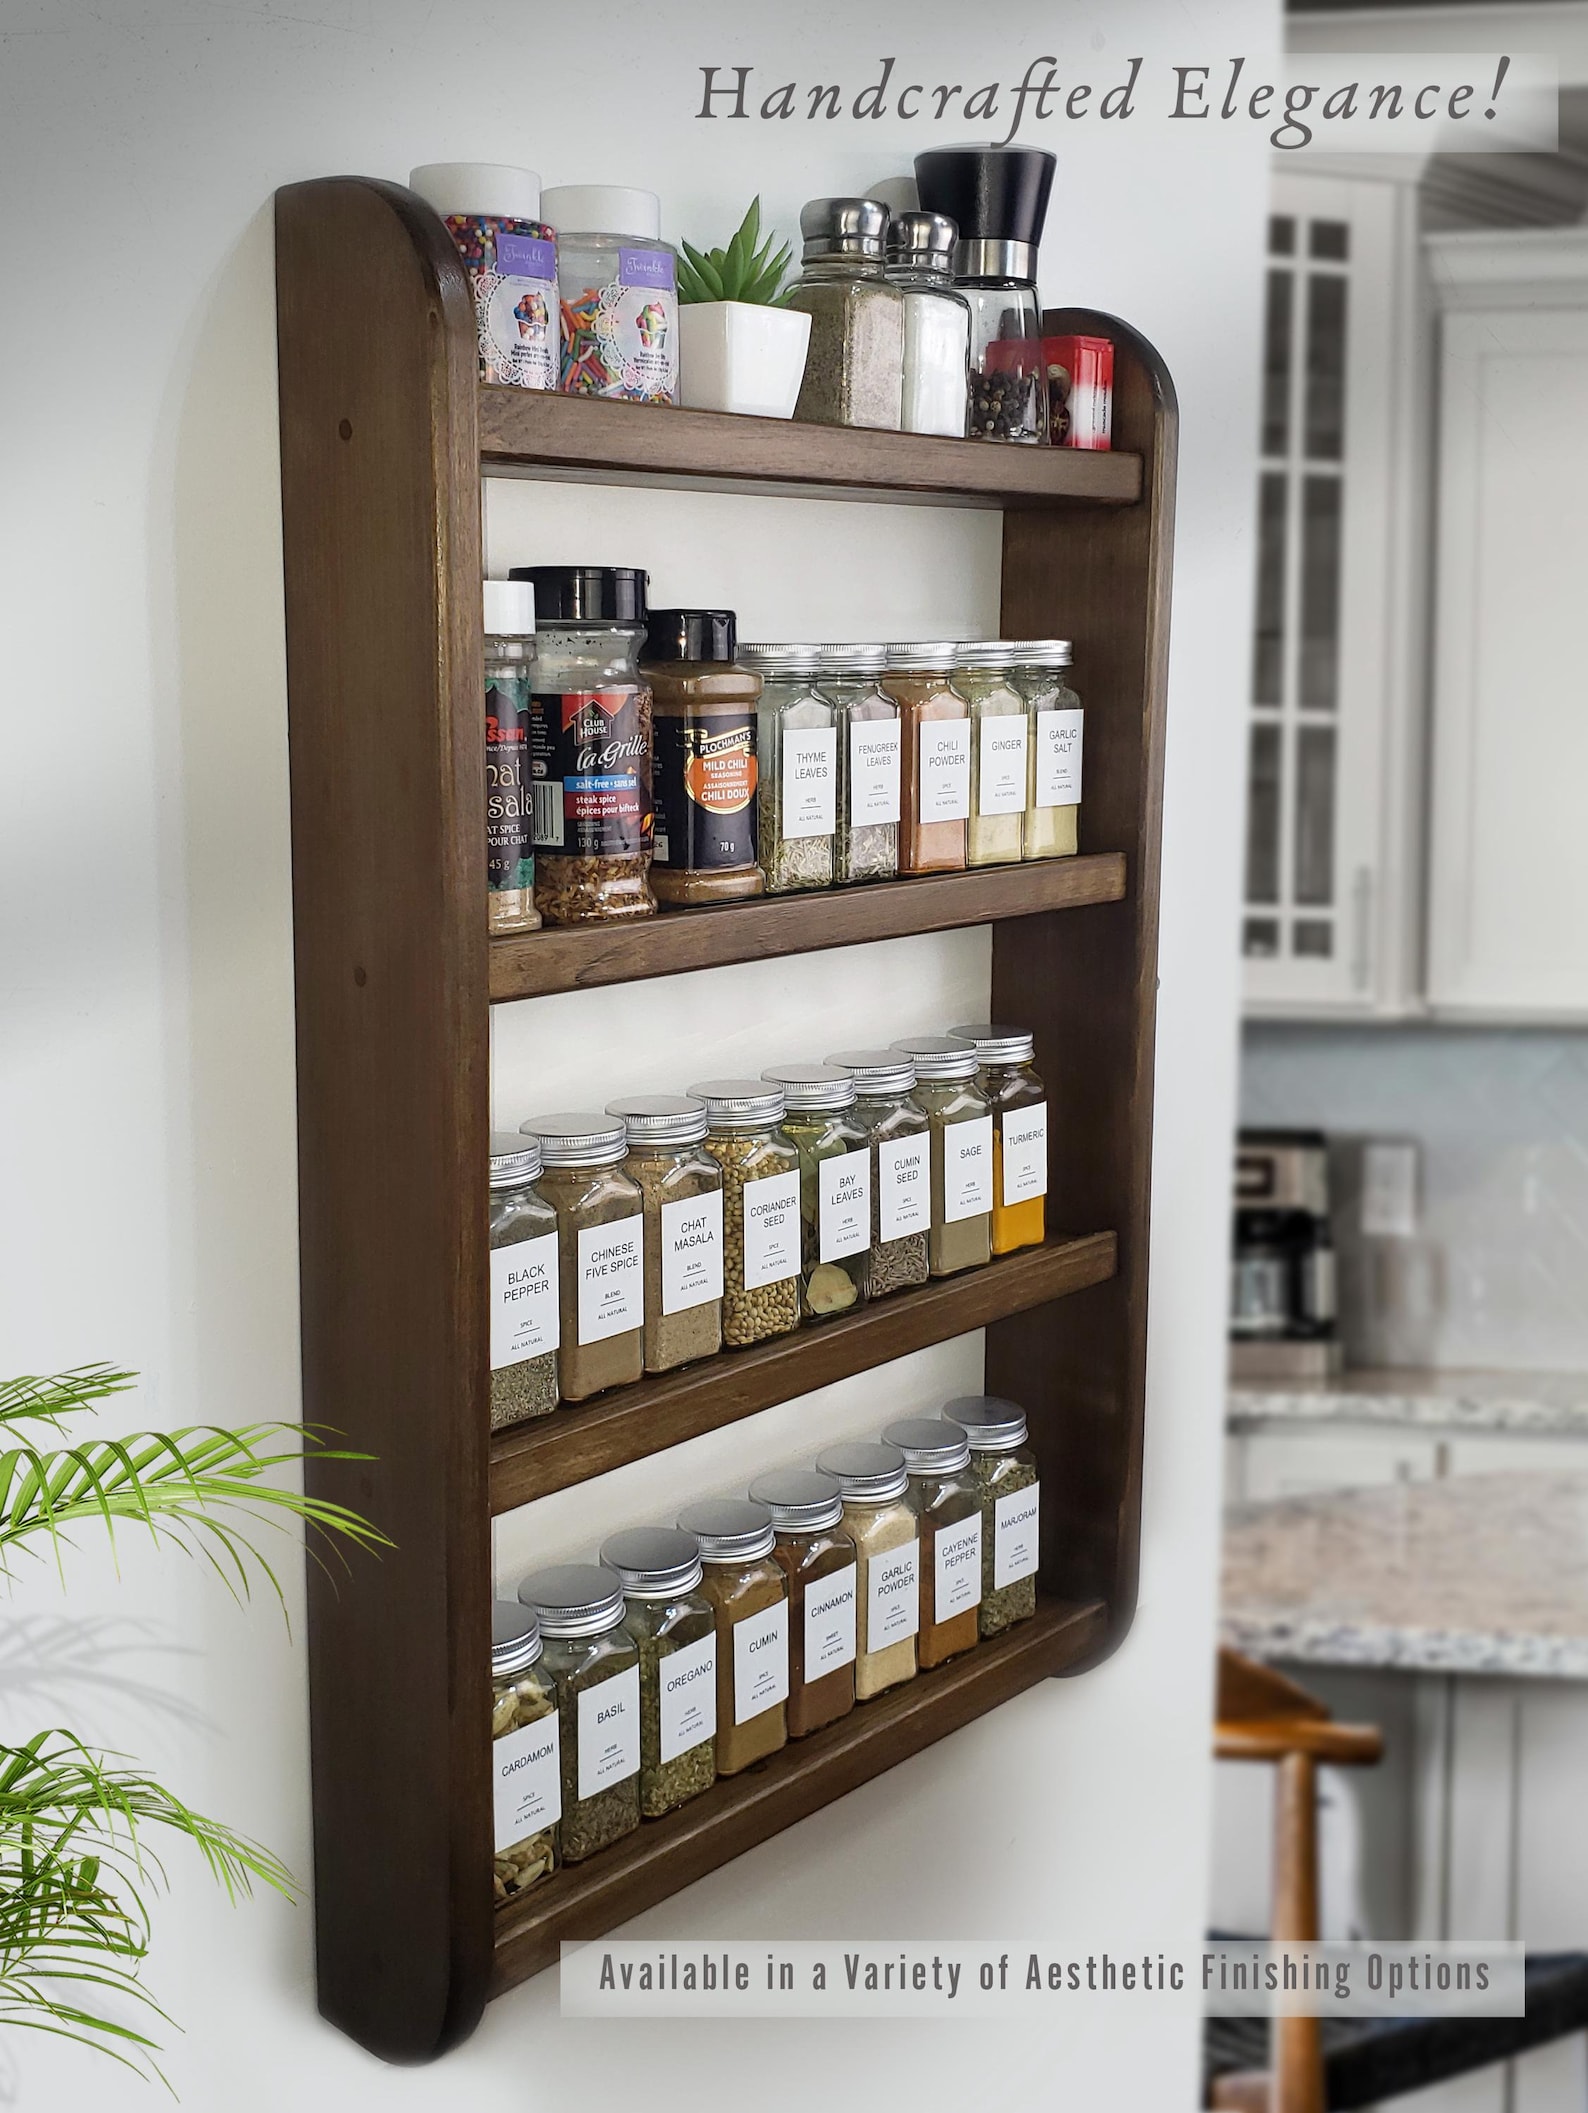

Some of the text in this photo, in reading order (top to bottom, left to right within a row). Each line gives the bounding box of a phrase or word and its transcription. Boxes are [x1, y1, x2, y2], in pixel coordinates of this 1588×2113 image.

[626, 257, 663, 275] Twinkle
[584, 719, 604, 728] CLUB
[580, 726, 608, 738] HOUSE
[1049, 729, 1077, 740] GARLIC
[700, 731, 751, 754] PLOCHMAN'S
[858, 742, 898, 754] FENUGREEK
[937, 740, 958, 752] CHILI
[992, 740, 1022, 751] GINGER
[1054, 743, 1072, 753] SALT
[797, 752, 827, 764] THYME
[866, 756, 891, 767] LEAVES
[929, 754, 965, 767] POWDER
[703, 759, 747, 771] MILD CHILI
[795, 767, 828, 779] LEAVES
[576, 777, 637, 789] salt-free sans sel
[576, 795, 616, 804] steak spice
[701, 788, 749, 801] CHILI DOUX
[488, 786, 533, 819] sala
[576, 802, 639, 816] épices pour bifteck
[499, 824, 520, 834] SPICE
[511, 834, 527, 845] CHAT
[577, 837, 592, 848] 130
[594, 840, 599, 850] g
[720, 842, 734, 852] 70 g
[489, 859, 510, 870] 45 g
[1009, 1128, 1044, 1146] TURMERIC
[960, 1145, 982, 1159] SAGE
[894, 1156, 920, 1170] CUMIN
[840, 1174, 856, 1188] BAY
[896, 1170, 918, 1184] SEED
[831, 1187, 863, 1205] LEAVES
[750, 1196, 796, 1217] CORIANDER
[681, 1217, 706, 1233] CHAT
[763, 1214, 785, 1228] SEED
[674, 1231, 714, 1252] MASALA
[591, 1242, 634, 1262] CHINESE
[585, 1255, 638, 1280] FIVE SPICE
[687, 1262, 702, 1271] BLEND
[769, 1258, 787, 1268] NATURAL
[508, 1264, 545, 1285] BLACK
[689, 1278, 708, 1289] NATURAL
[504, 1280, 549, 1303] PEPPER
[604, 1290, 620, 1300] BLEND
[607, 1306, 627, 1317] NATURAL
[520, 1319, 533, 1328] SPICE
[521, 1336, 543, 1349] NATURAL
[1001, 1507, 1036, 1530] MARJORAM
[942, 1533, 978, 1557] CAYENNE
[945, 1548, 976, 1569] PEPPER
[882, 1561, 912, 1581] GARLIC
[878, 1573, 914, 1597] POWDER
[811, 1590, 853, 1618] CINNAMON
[750, 1629, 778, 1653] CUMIN
[667, 1660, 712, 1692] OREGANO
[597, 1702, 625, 1724] BASIL
[604, 1744, 617, 1753] HERB
[502, 1742, 553, 1777] CARDAMOM
[606, 1758, 625, 1771] NATURAL
[523, 1792, 535, 1802] SPICE
[524, 1806, 545, 1819] NATURAL
